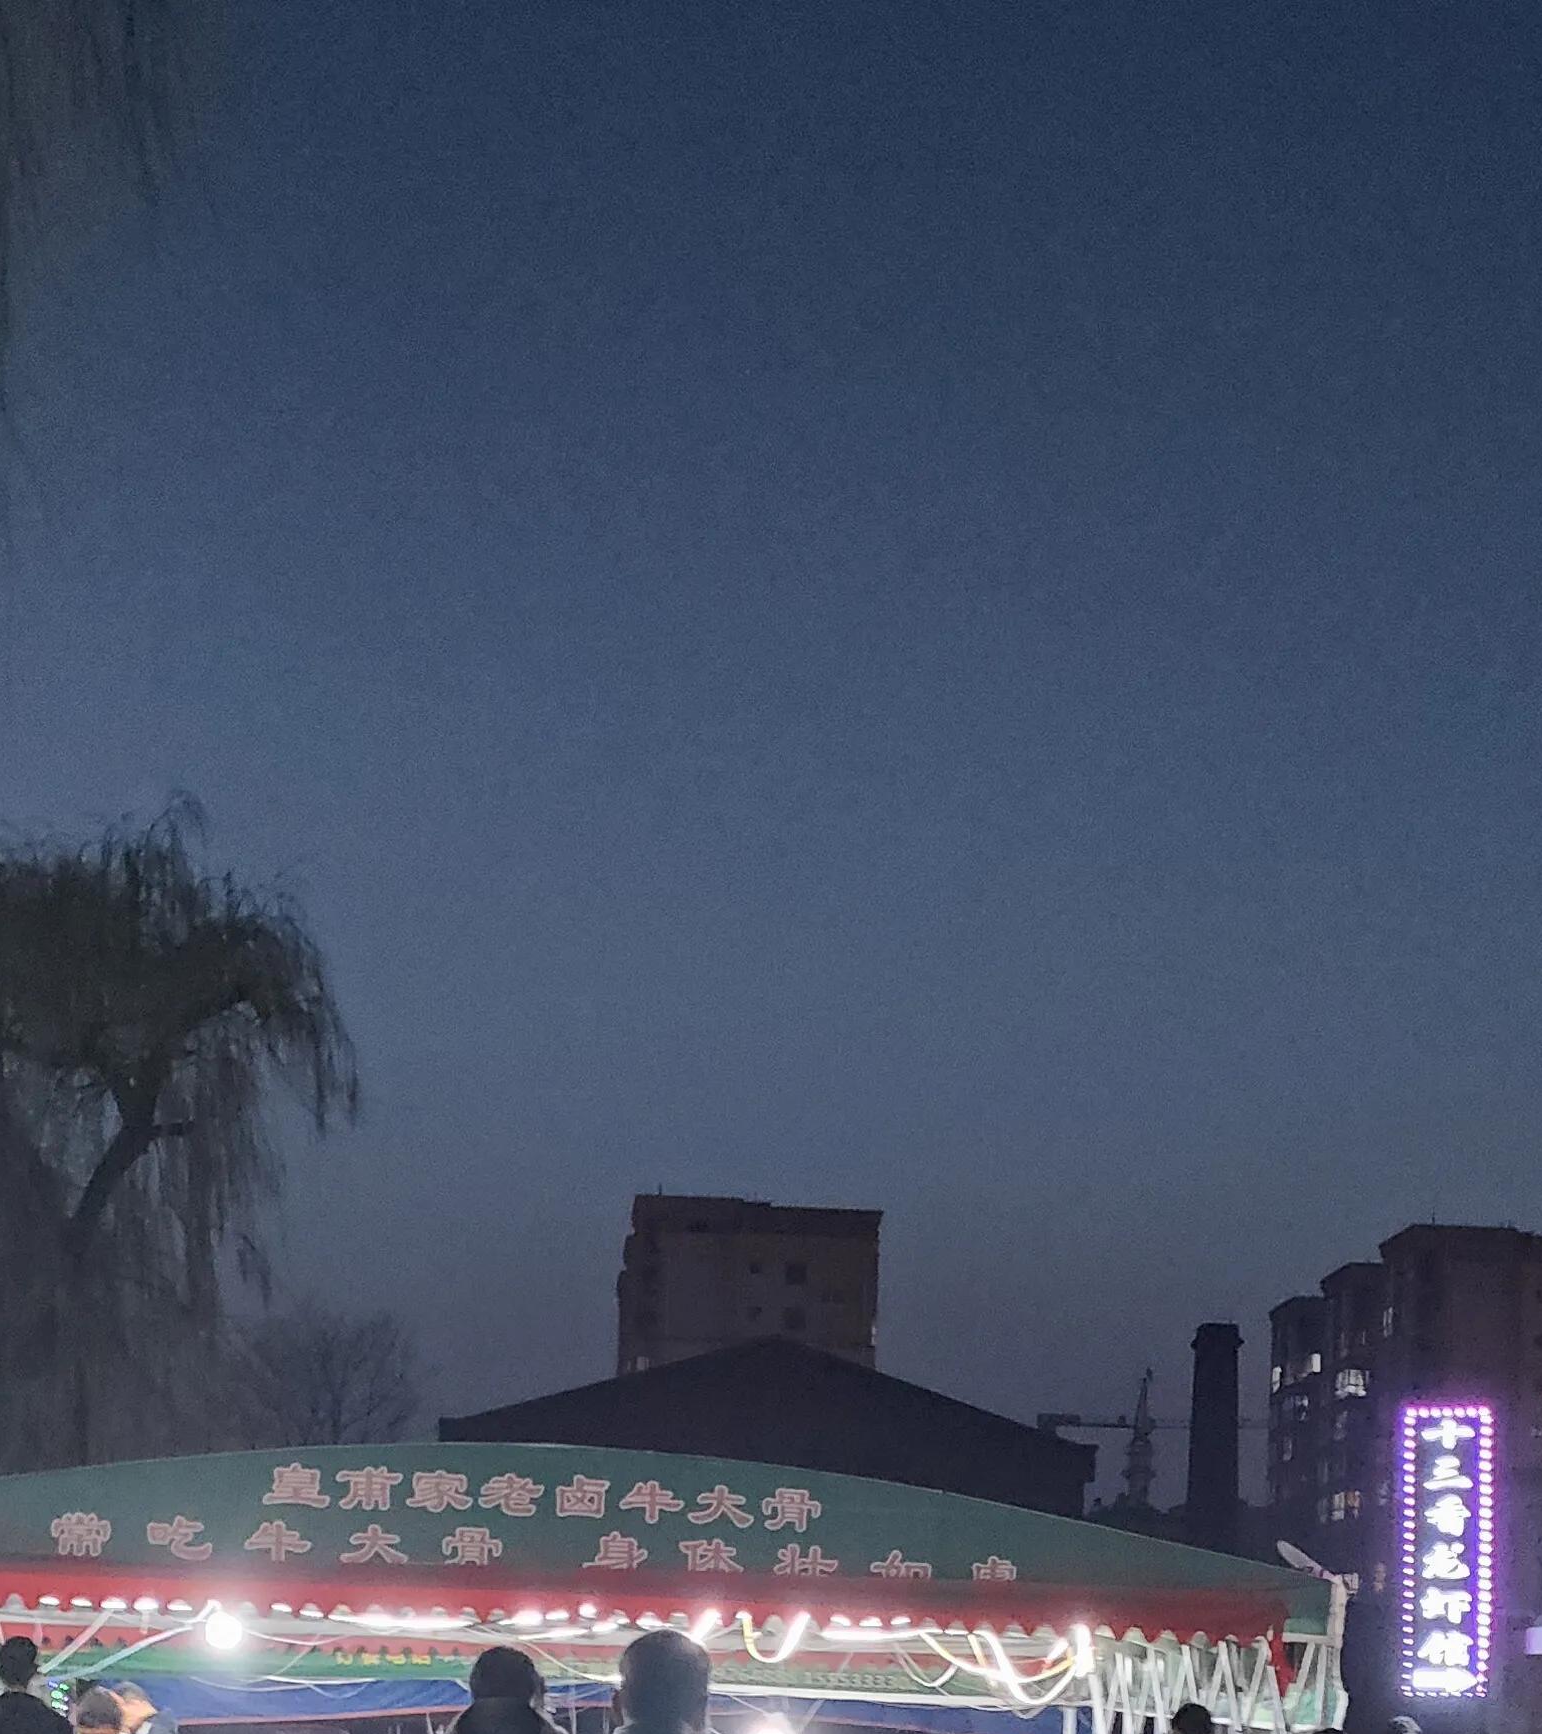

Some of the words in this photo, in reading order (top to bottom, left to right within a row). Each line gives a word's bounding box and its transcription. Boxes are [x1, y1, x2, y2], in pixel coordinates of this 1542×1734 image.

[262, 1462, 822, 1533] 皇甫家老卤牛大骨
[50, 1511, 503, 1566] 常吃牛大骨
